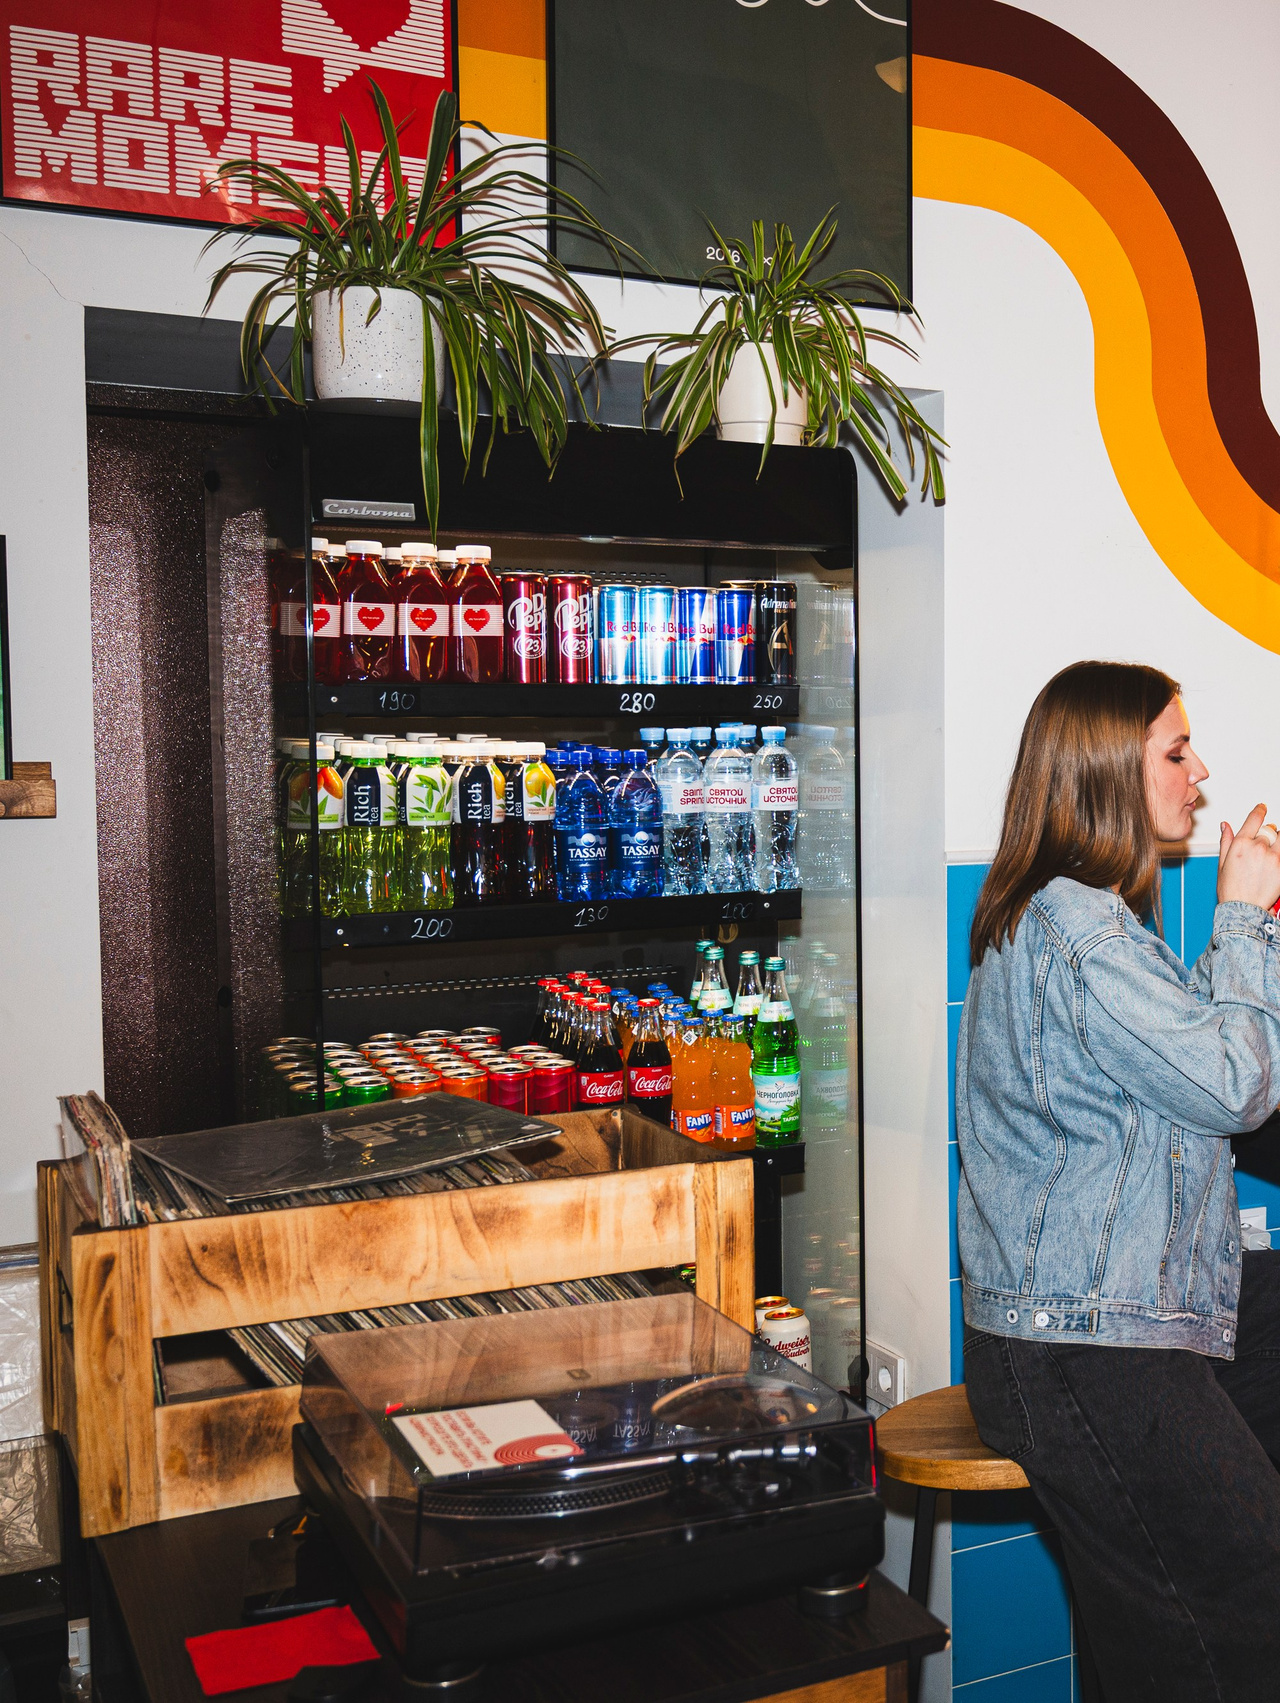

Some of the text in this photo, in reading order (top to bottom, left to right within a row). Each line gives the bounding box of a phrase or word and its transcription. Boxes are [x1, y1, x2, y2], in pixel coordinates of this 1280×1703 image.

[10, 24, 293, 137] RARE
[706, 246, 740, 263] 206
[324, 503, 413, 519] Carboma
[761, 598, 797, 612] Adrenalin
[723, 623, 757, 635] Red Bu
[526, 638, 540, 652] 23
[379, 691, 416, 711] 190
[619, 692, 656, 713] 280
[753, 695, 783, 709] 250
[709, 788, 743, 796] СВЯТОЙ
[769, 787, 798, 795] СВЯТО
[354, 785, 371, 822] Rich
[467, 782, 482, 819] Rich
[763, 795, 798, 803] ИСТОЧН
[370, 806, 379, 823] tea
[483, 804, 491, 819] tea
[568, 847, 607, 859] TASSAY
[621, 845, 660, 856] TASSAY
[574, 905, 609, 927] 130
[722, 902, 753, 919] 100
[411, 917, 453, 939] 200
[756, 1088, 799, 1099] ЧЕРНОГОЛОВКА
[686, 1113, 712, 1127] FANTA
[730, 1107, 755, 1122] FANTA
